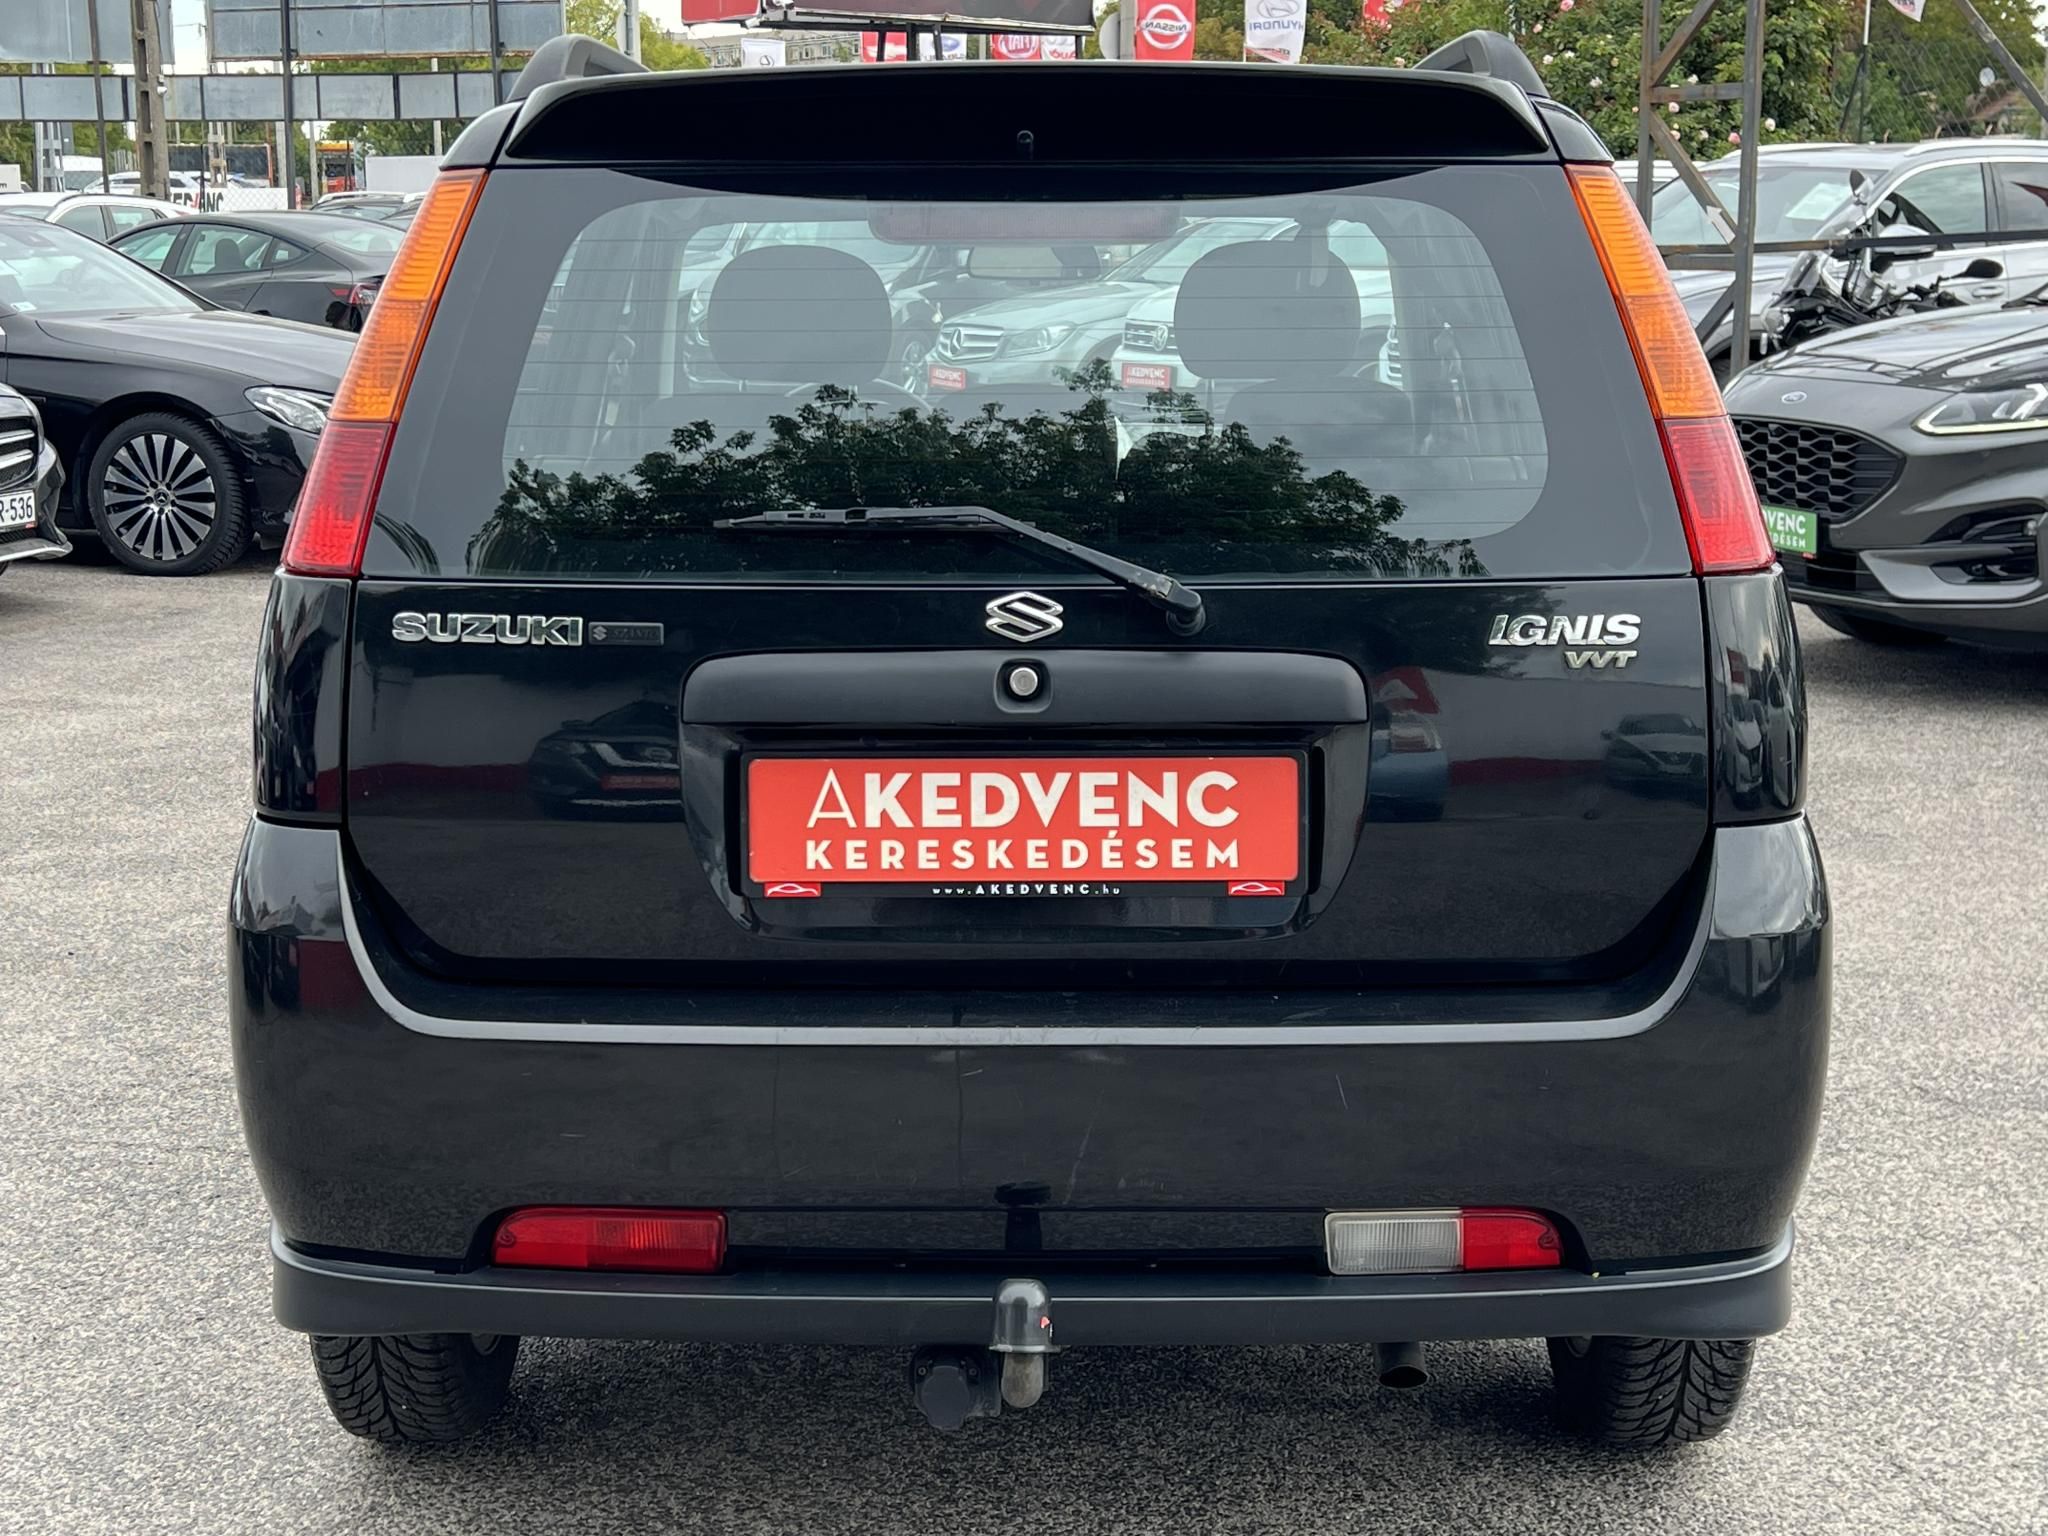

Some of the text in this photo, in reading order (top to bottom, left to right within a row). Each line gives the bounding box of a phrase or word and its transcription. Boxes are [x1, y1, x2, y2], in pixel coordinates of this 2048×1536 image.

[392, 612, 583, 646] SUZUKI
[1488, 613, 1641, 647] IGNIS
[1564, 650, 1638, 669] VVT
[805, 829, 1239, 870] KERESKEDÉSEM
[932, 884, 1121, 896] www.AKEDVENC.hu
